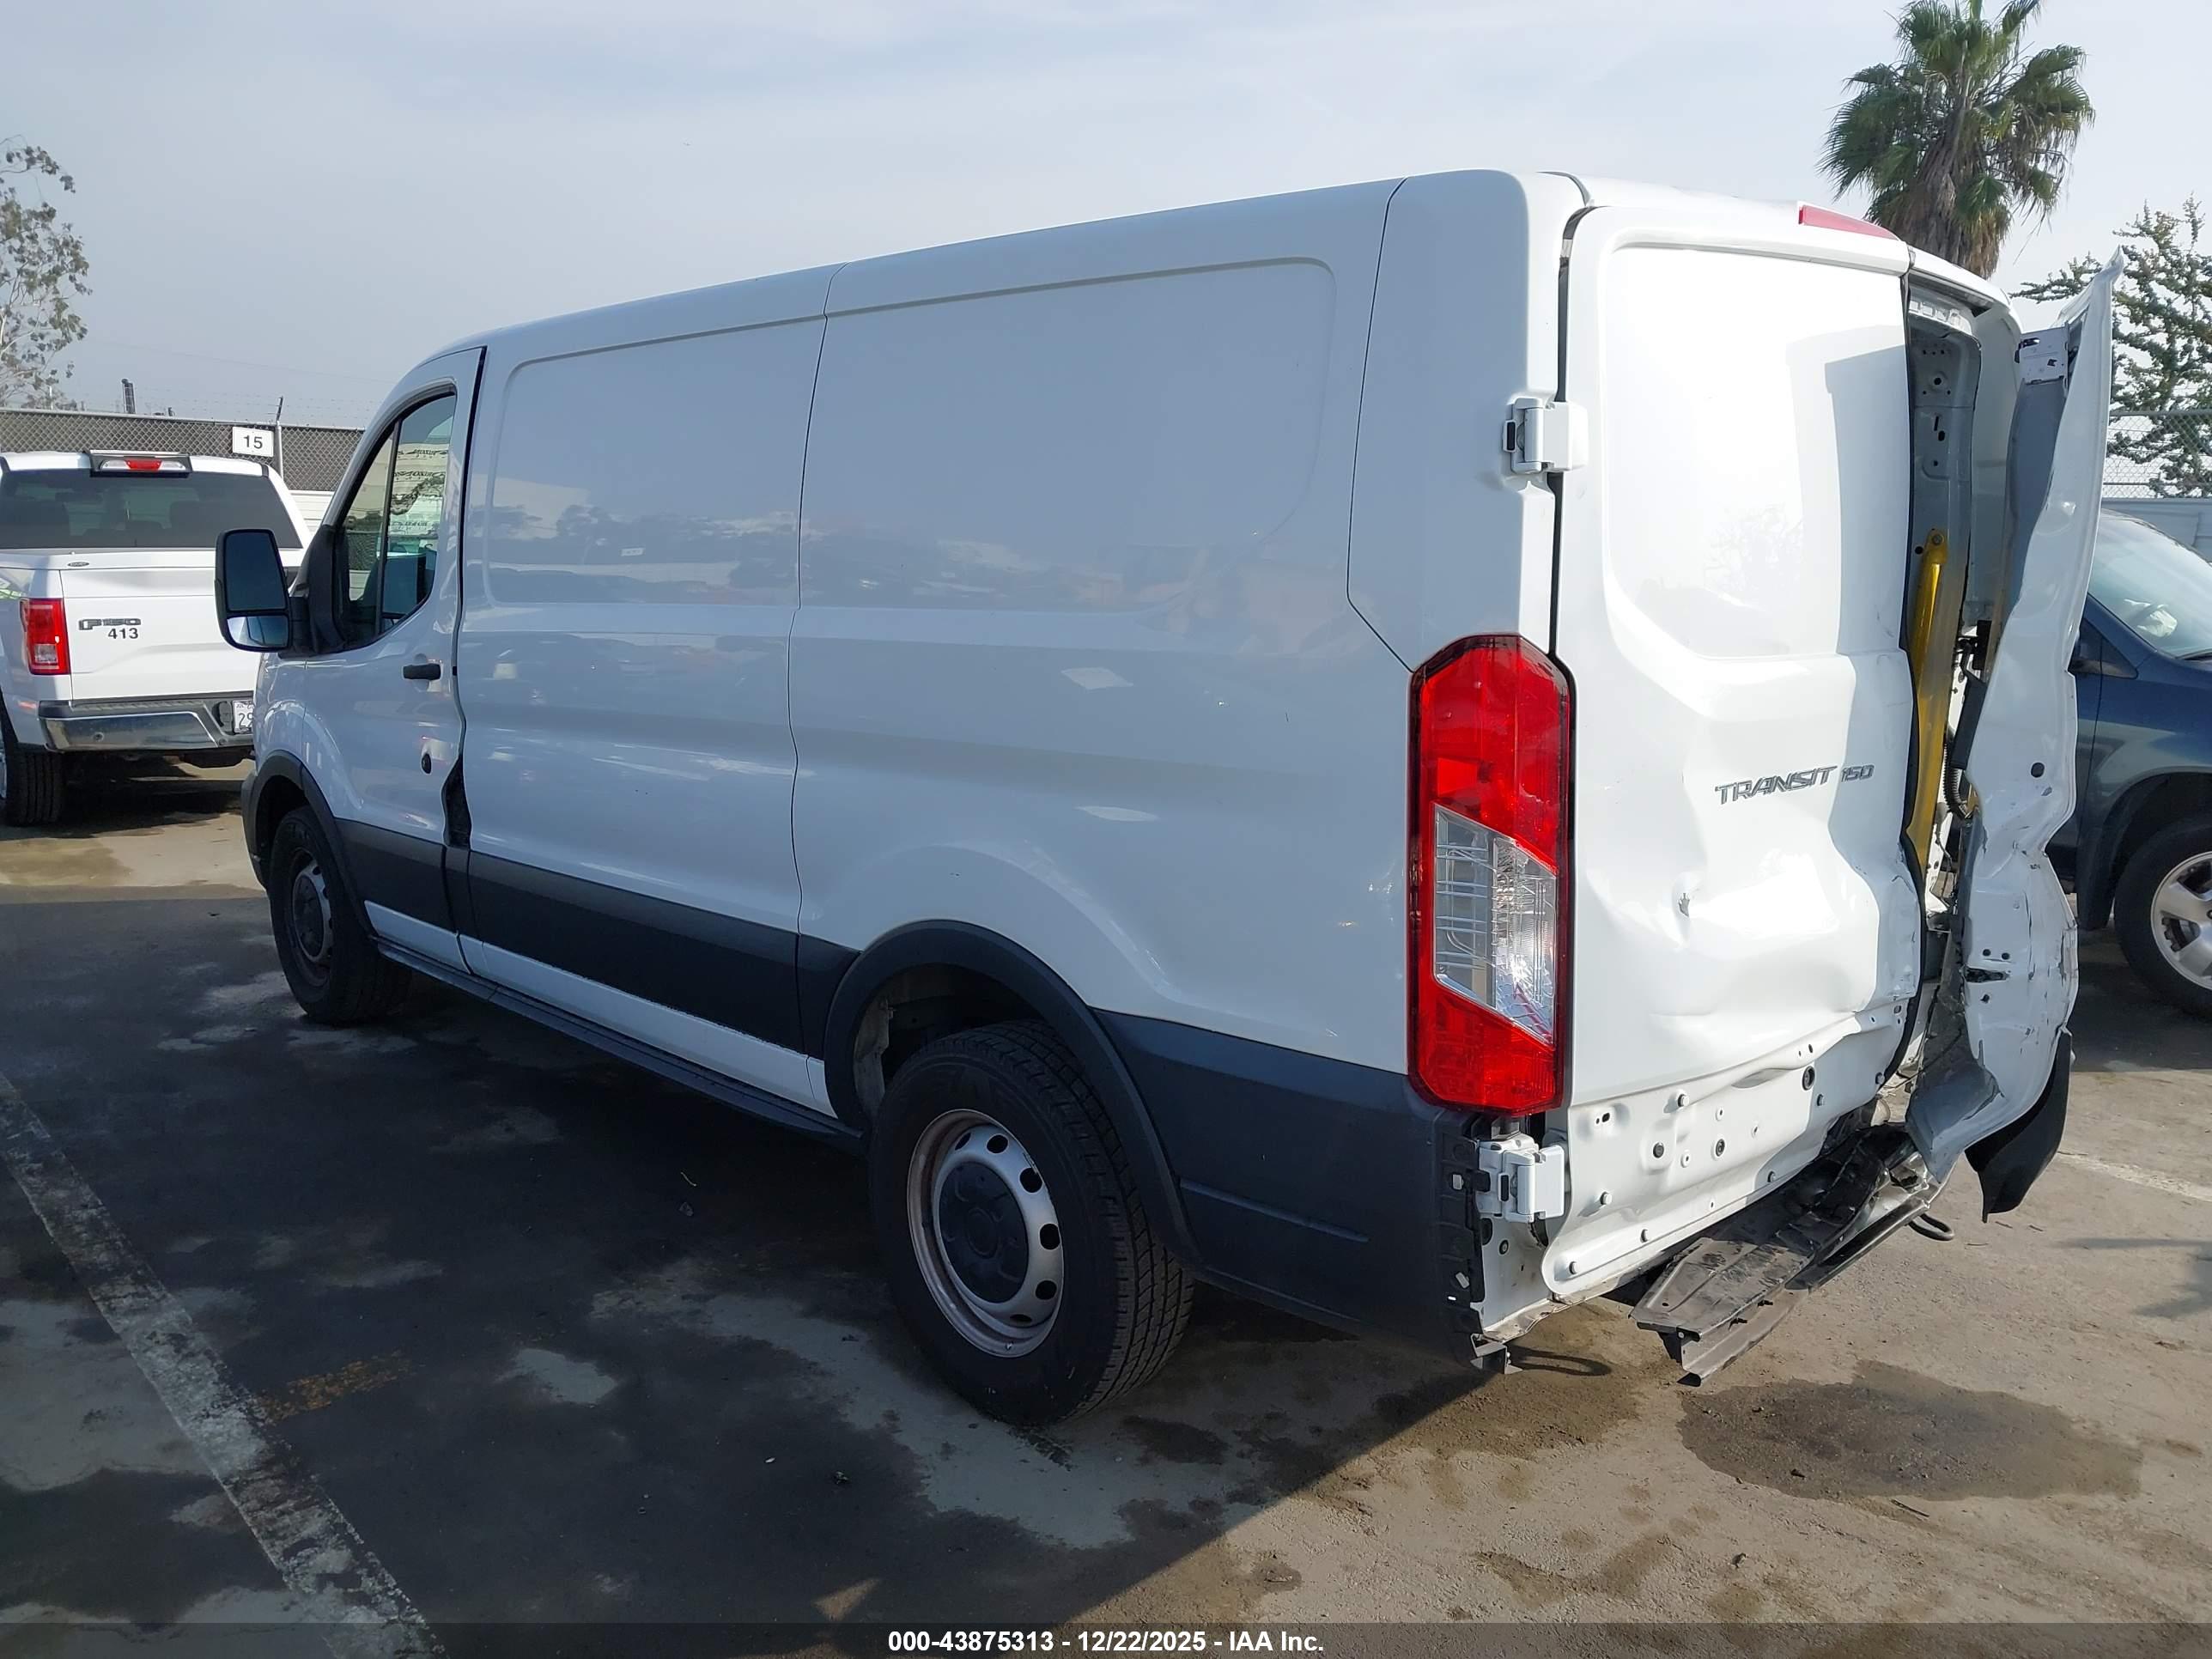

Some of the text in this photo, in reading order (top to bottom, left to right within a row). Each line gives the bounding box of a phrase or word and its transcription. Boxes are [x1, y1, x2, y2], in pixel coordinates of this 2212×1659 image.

[243, 434, 263, 449] 15
[107, 628, 138, 639] 413
[1715, 763, 1875, 805] TRANSIT 150
